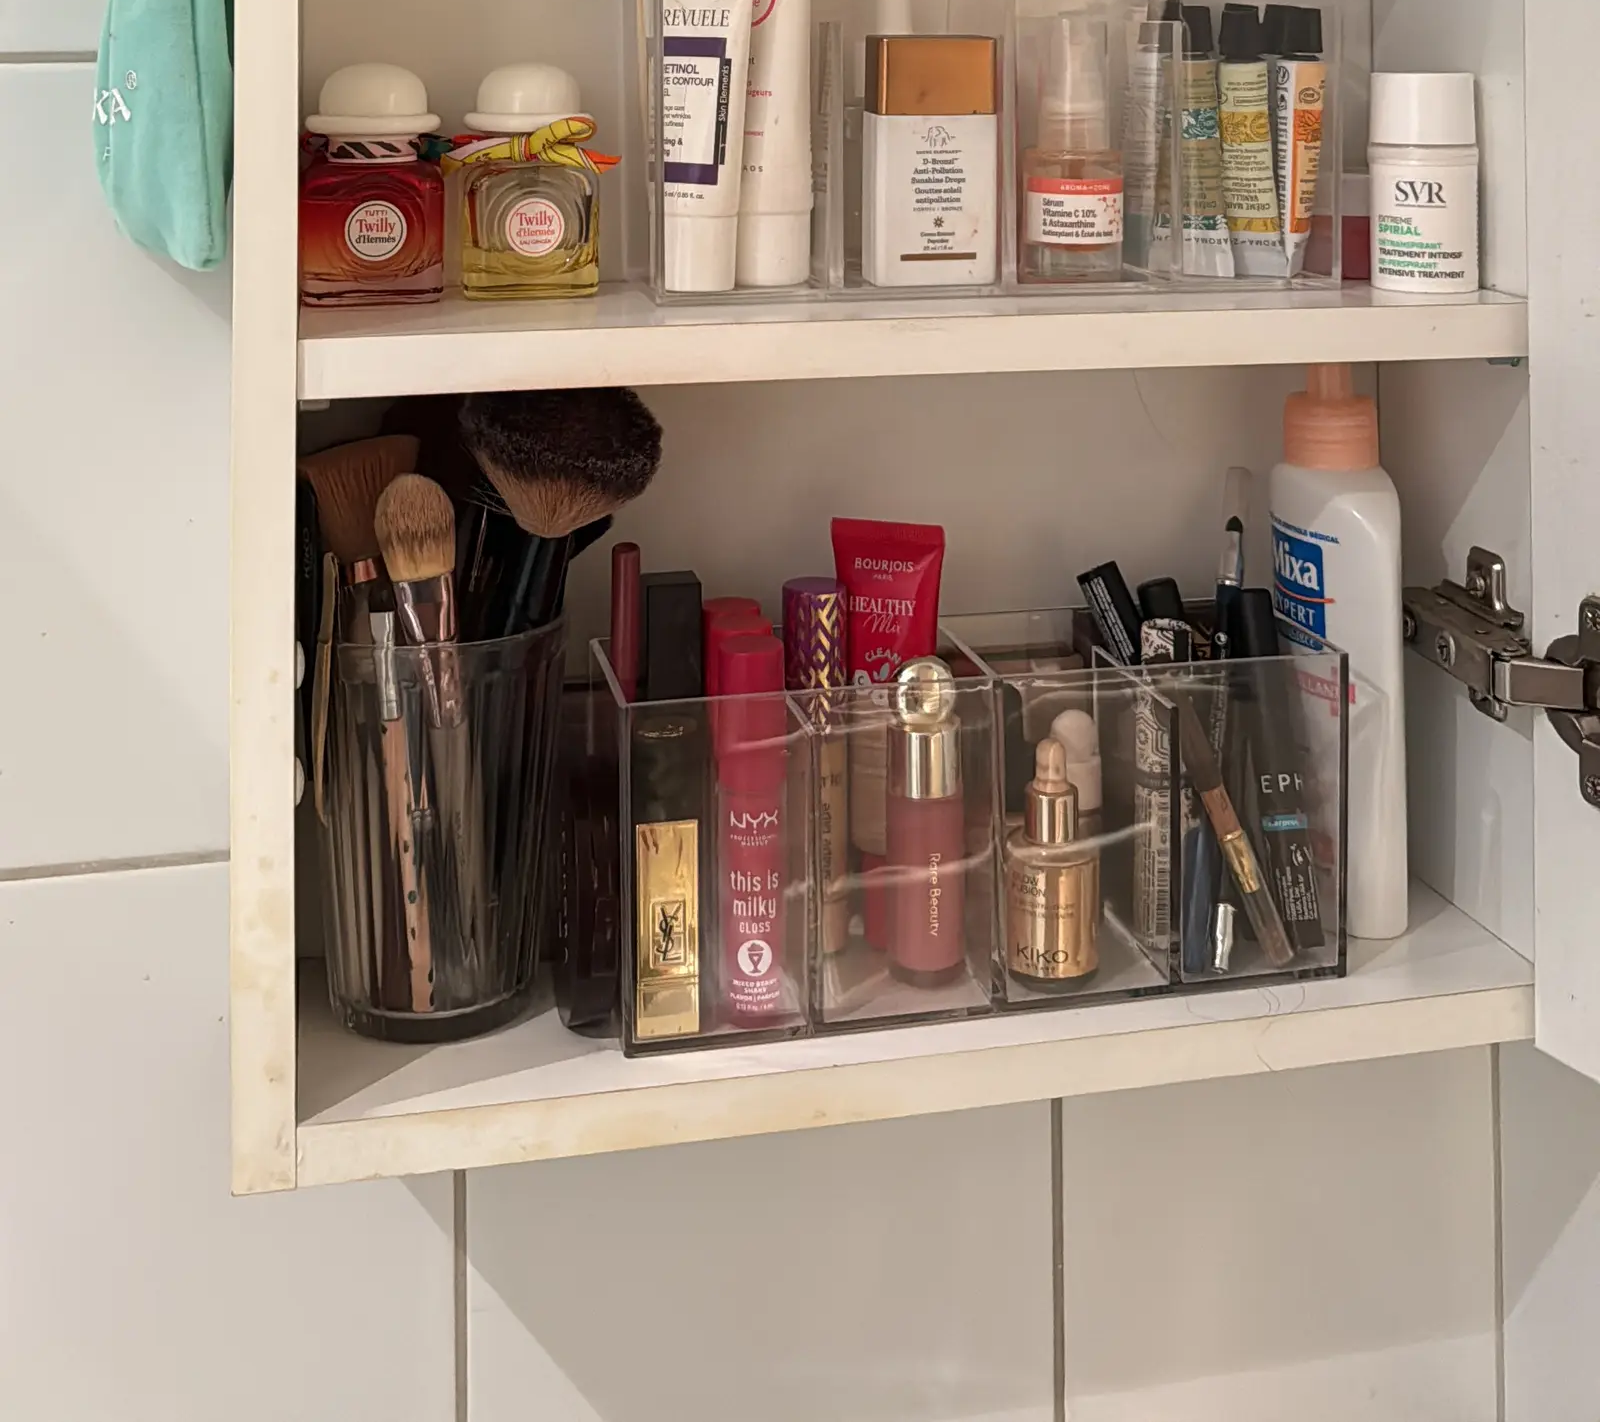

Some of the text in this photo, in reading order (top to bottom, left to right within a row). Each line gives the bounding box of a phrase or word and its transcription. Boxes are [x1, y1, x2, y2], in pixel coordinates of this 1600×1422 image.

[663, 64, 699, 75] ETINOL
[672, 77, 714, 86] CONTOUR
[718, 65, 730, 122] Skin Elements
[913, 167, 964, 175] Anti-Pollution
[911, 176, 966, 185] Sunshine Drops
[914, 187, 942, 195] Gouttes
[1395, 180, 1446, 203] SVR
[1042, 198, 1064, 207] Sérum
[365, 209, 388, 217] TUTTI
[516, 210, 554, 230] Twilly
[1042, 208, 1097, 218] Vitamine C 10%
[355, 217, 396, 235] Twilly
[1042, 218, 1095, 228] & Astaxanthine
[1378, 223, 1421, 237] SPIRIAL
[355, 233, 396, 244] d'Hermès
[1379, 248, 1463, 260] TRAITEMENT INTENSIF
[1378, 267, 1465, 279] INTENSIVE TREATMENT
[854, 557, 915, 573] BOURJOIS
[1272, 537, 1320, 591] Mixa
[850, 595, 916, 617] HEALTHY
[865, 647, 901, 664] CLEAN
[730, 809, 778, 829] NYX
[928, 852, 941, 885] Rare
[730, 869, 779, 893] this is
[733, 896, 777, 919] milky
[927, 888, 941, 937] Beauty
[655, 900, 683, 962] YSL
[739, 921, 771, 934] GLOSS
[1016, 942, 1069, 964] KIKO
